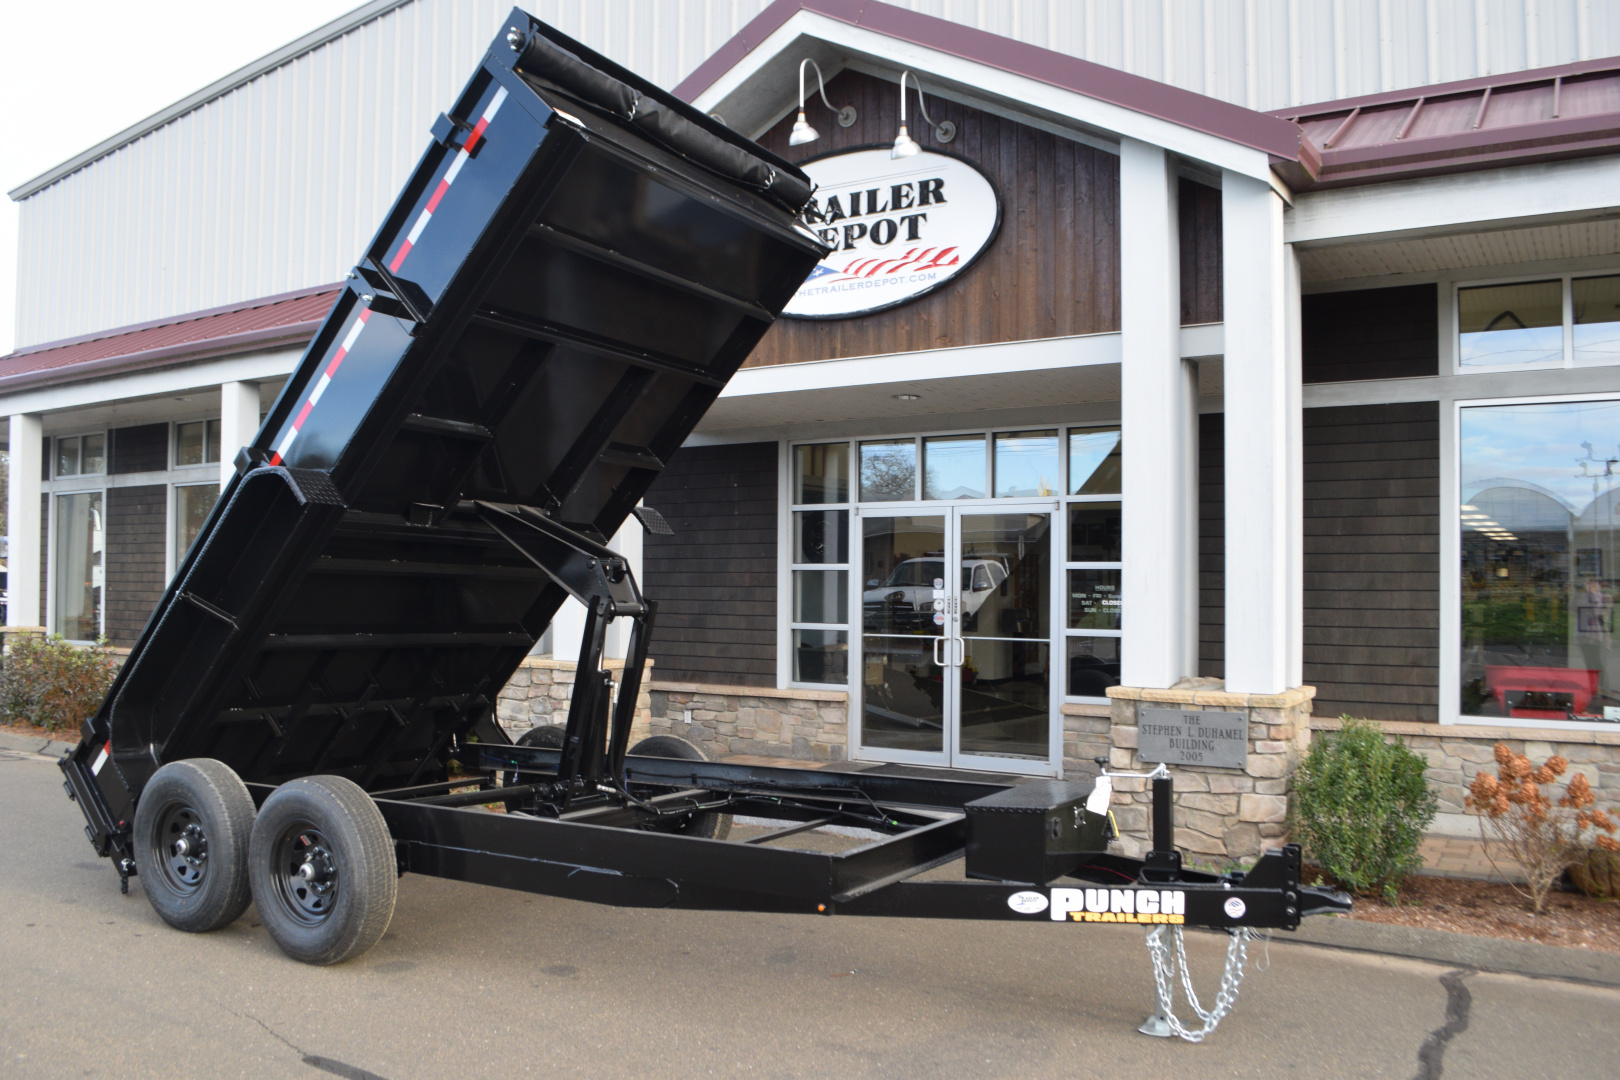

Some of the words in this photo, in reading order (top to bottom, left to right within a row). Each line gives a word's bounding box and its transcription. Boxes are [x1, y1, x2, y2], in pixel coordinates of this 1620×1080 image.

[818, 213, 927, 252] EPOT
[1184, 715, 1200, 725] THE
[1142, 725, 1182, 736] STEPHEN
[1198, 728, 1244, 740] DUHAMEL
[1169, 738, 1214, 750] BUILDING
[1180, 752, 1203, 761] 2005
[1050, 888, 1185, 921] PUNCH
[1069, 912, 1185, 924] TRAILERS
